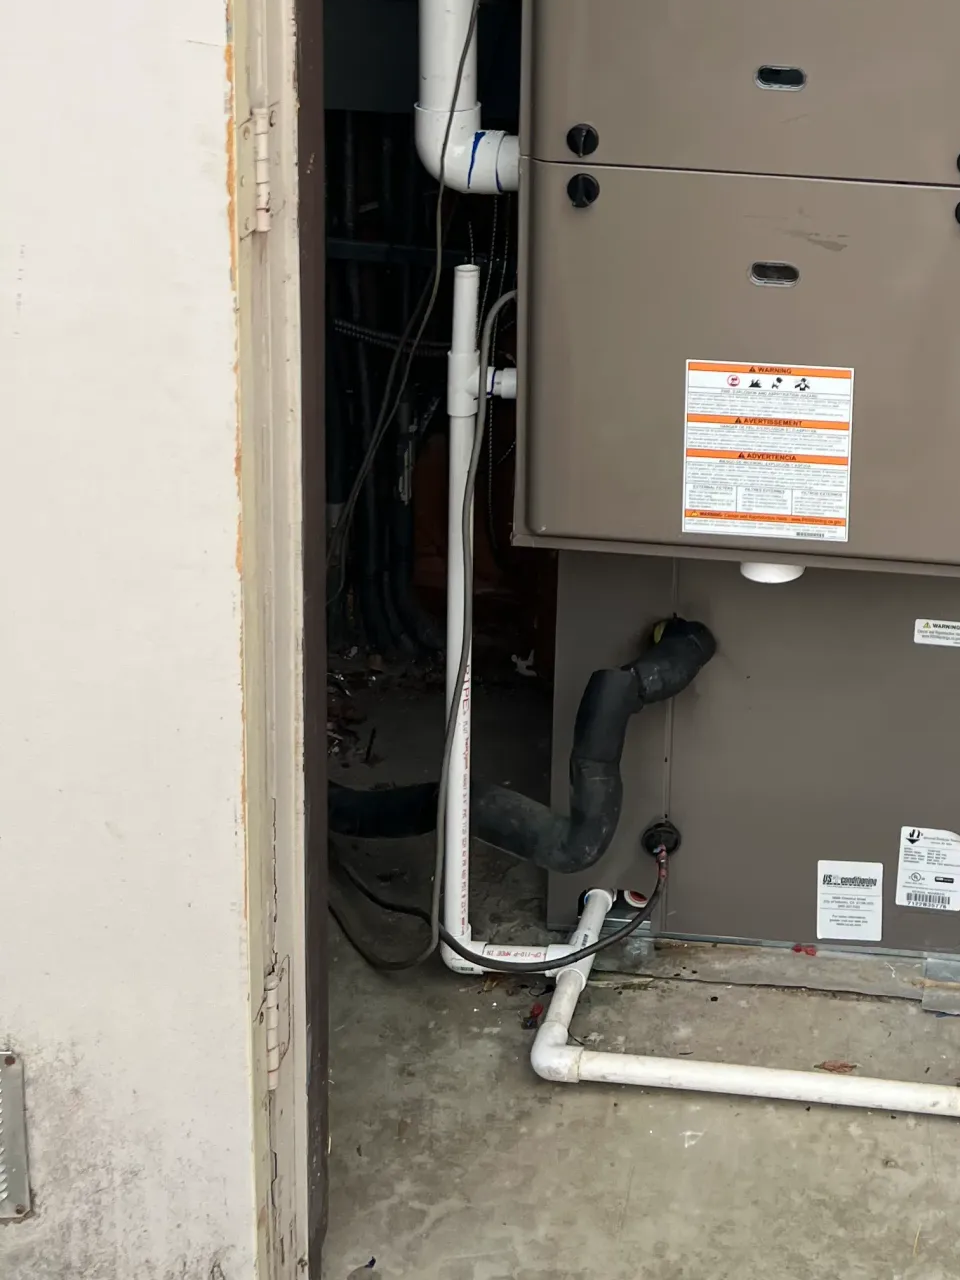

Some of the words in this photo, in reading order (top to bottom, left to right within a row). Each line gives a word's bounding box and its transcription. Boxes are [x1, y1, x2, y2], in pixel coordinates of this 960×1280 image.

[758, 367, 792, 375] WARNING
[744, 418, 802, 427] AVERTISSEMENT
[746, 453, 796, 461] ADVERTENCIA
